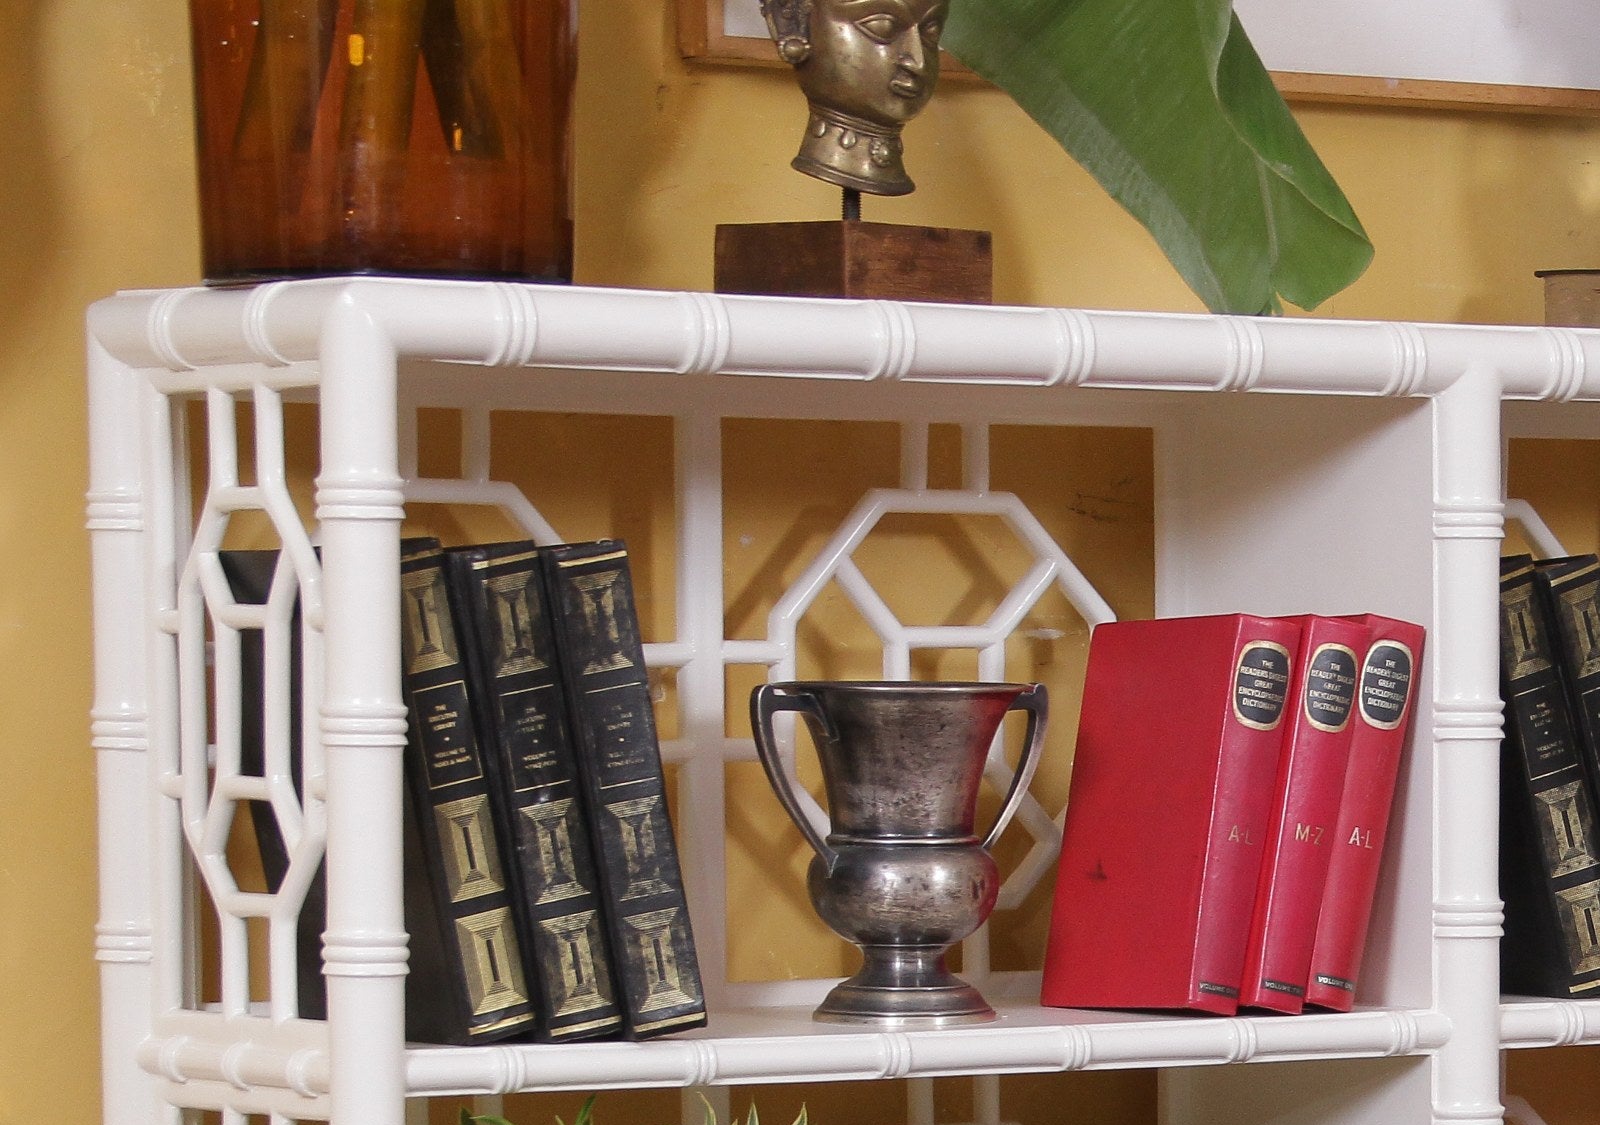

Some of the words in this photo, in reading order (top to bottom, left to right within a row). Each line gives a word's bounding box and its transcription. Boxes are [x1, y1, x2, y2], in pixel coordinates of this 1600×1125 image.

[1262, 660, 1274, 669] THE
[1330, 663, 1341, 671] THE
[1385, 660, 1396, 668] THE
[1254, 680, 1274, 689] GREAT
[1323, 682, 1341, 691] GREAT
[1378, 679, 1396, 688] GREAT
[1243, 698, 1277, 711] DICTIONARY
[1313, 701, 1345, 713] DICTIONARY
[1367, 697, 1398, 711] DICTIONARY
[1228, 825, 1253, 845] A-L
[1295, 823, 1325, 845] M-Z
[1348, 827, 1373, 849] A-L
